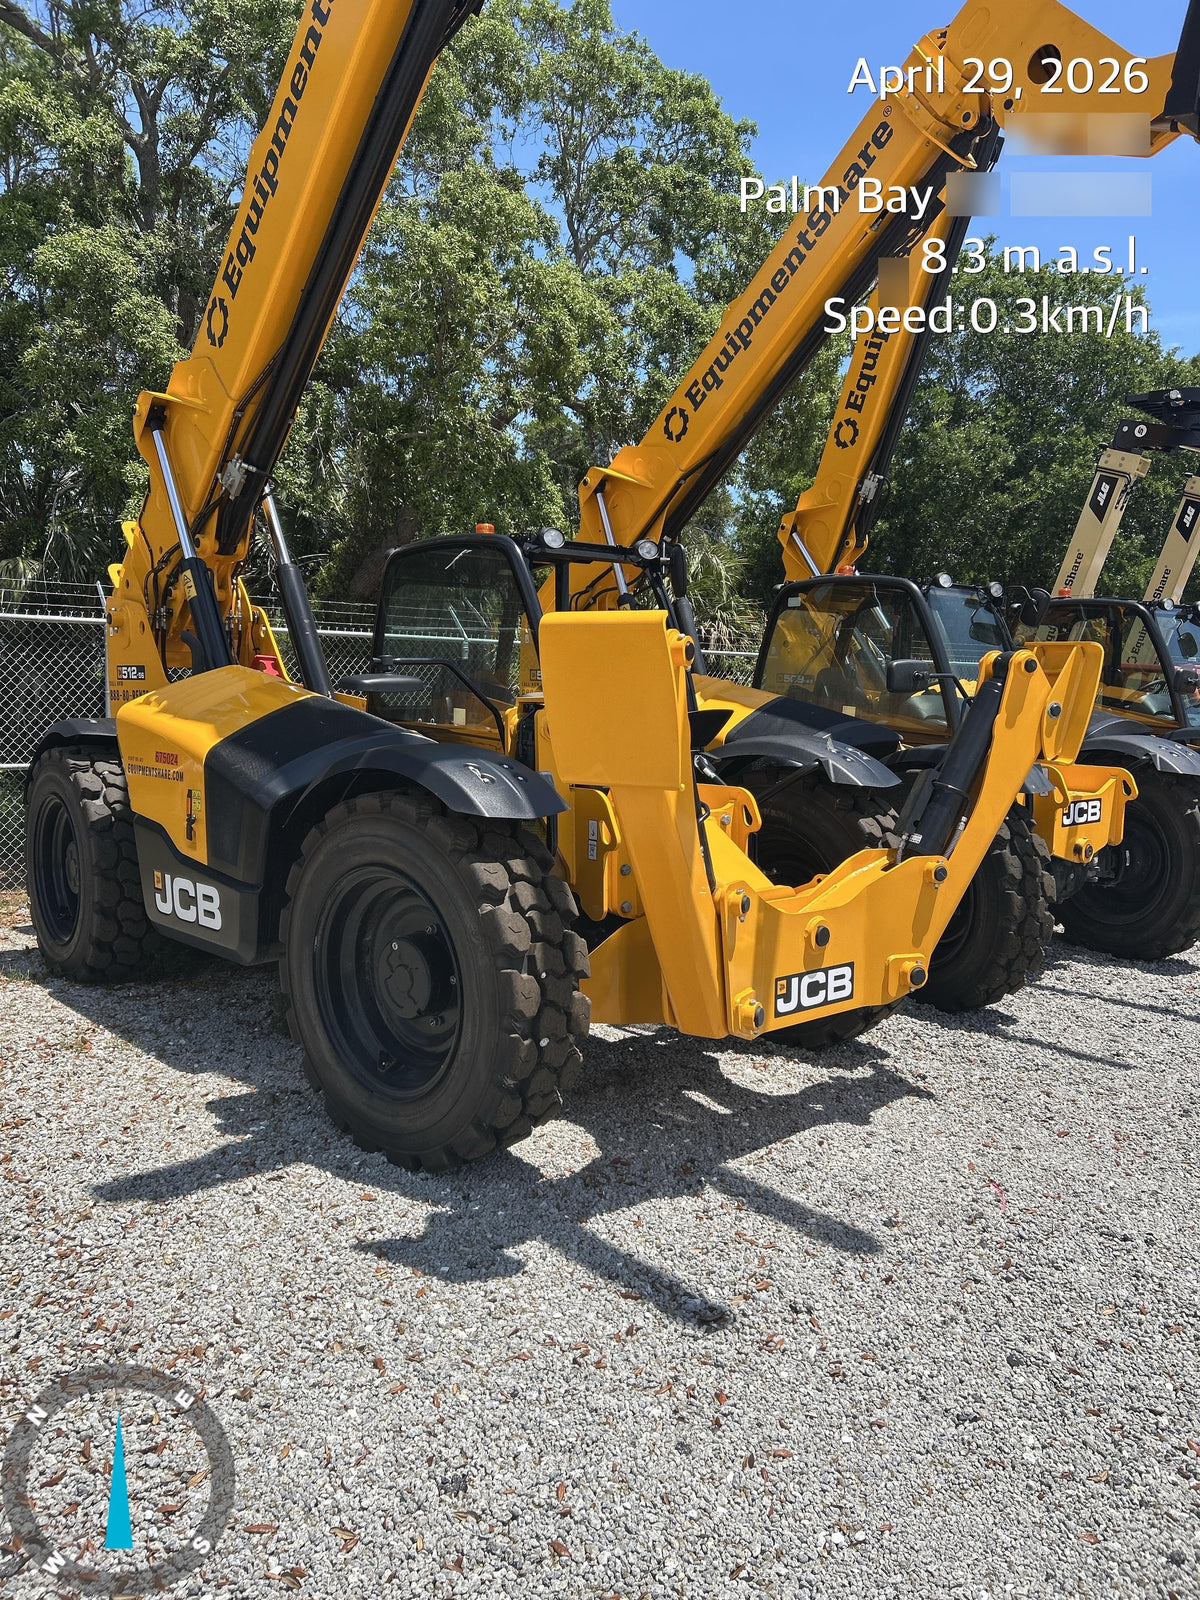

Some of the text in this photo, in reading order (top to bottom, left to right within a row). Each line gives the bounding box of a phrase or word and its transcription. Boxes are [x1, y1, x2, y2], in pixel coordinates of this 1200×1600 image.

[222, 0, 335, 300] Equipment
[845, 306, 894, 413] Equip
[1097, 482, 1110, 506] JLG
[1183, 505, 1196, 528] JLG
[1064, 552, 1084, 590] Share
[1152, 568, 1172, 601] Share
[127, 763, 184, 782] EQUIPMENTSHARE.COM
[155, 751, 179, 766] 675024
[1062, 800, 1101, 825] JCB
[155, 873, 222, 930] JCB
[776, 966, 853, 1013] JCB
